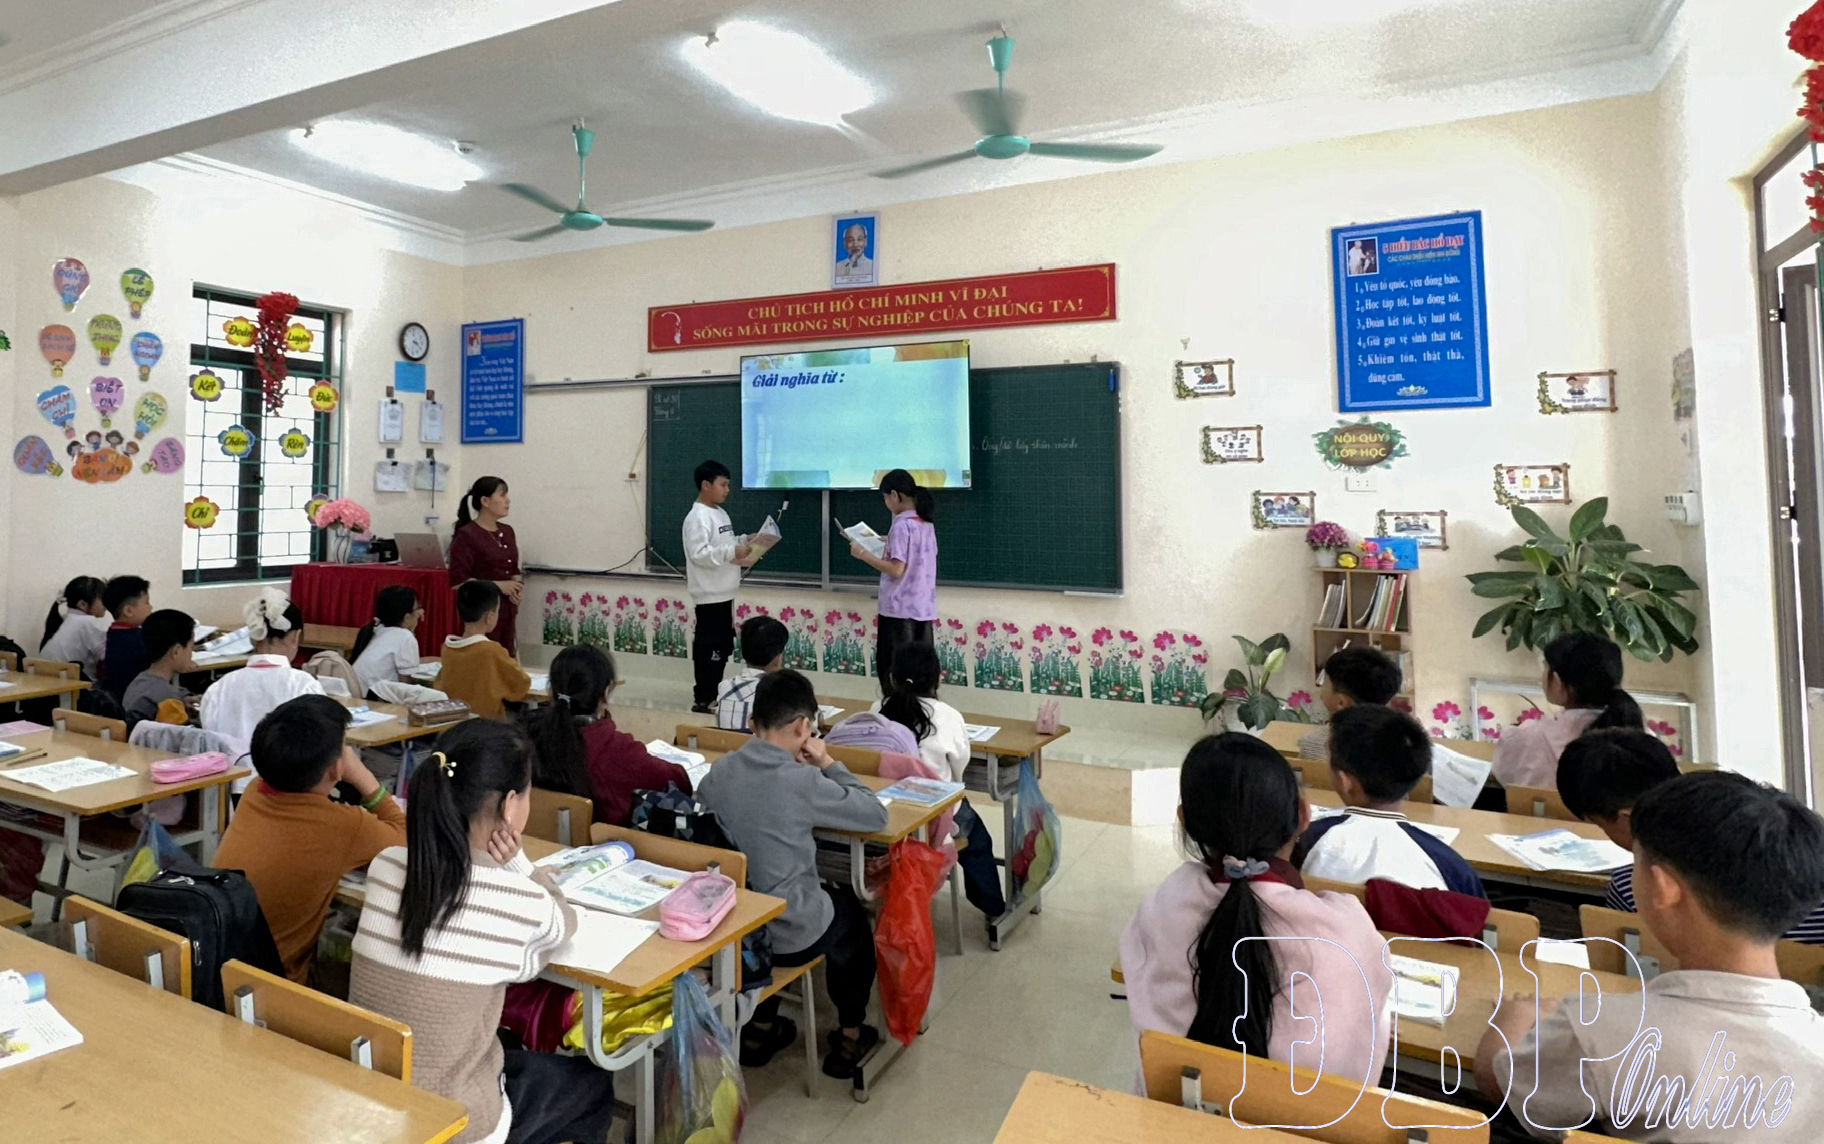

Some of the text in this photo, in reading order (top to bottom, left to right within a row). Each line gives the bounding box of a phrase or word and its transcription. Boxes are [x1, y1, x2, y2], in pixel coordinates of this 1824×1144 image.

[1364, 280, 1378, 292] Yêu
[1424, 275, 1442, 287] đồng
[125, 287, 151, 298] PHÉP
[748, 285, 1007, 319] CHỦ TỊCH HỒ CHÍ MINH VĨ ĐẠI
[1365, 299, 1379, 311] Học
[1427, 293, 1445, 306] động
[693, 298, 1083, 340] SỐNG MÃI TRONG SỰ NGHIỆP CỦA CHÚNG TA!
[1366, 317, 1384, 328] Đoàn
[1388, 315, 1399, 326] kết
[229, 325, 253, 338] Đoàn
[1411, 332, 1427, 343] sinh
[1368, 353, 1394, 365] Khiêm
[752, 373, 779, 388] Giải
[780, 372, 820, 389] nghĩa
[821, 369, 838, 384] từ
[1368, 372, 1387, 384] dũng
[95, 381, 121, 393] BIẾT
[198, 380, 216, 391] Kết
[142, 399, 165, 416] HỌC
[224, 435, 249, 447] Chăm
[286, 437, 304, 449] Rèn
[1334, 433, 1385, 444] NỘI QUY
[1335, 447, 1386, 458] LỚP HỌC
